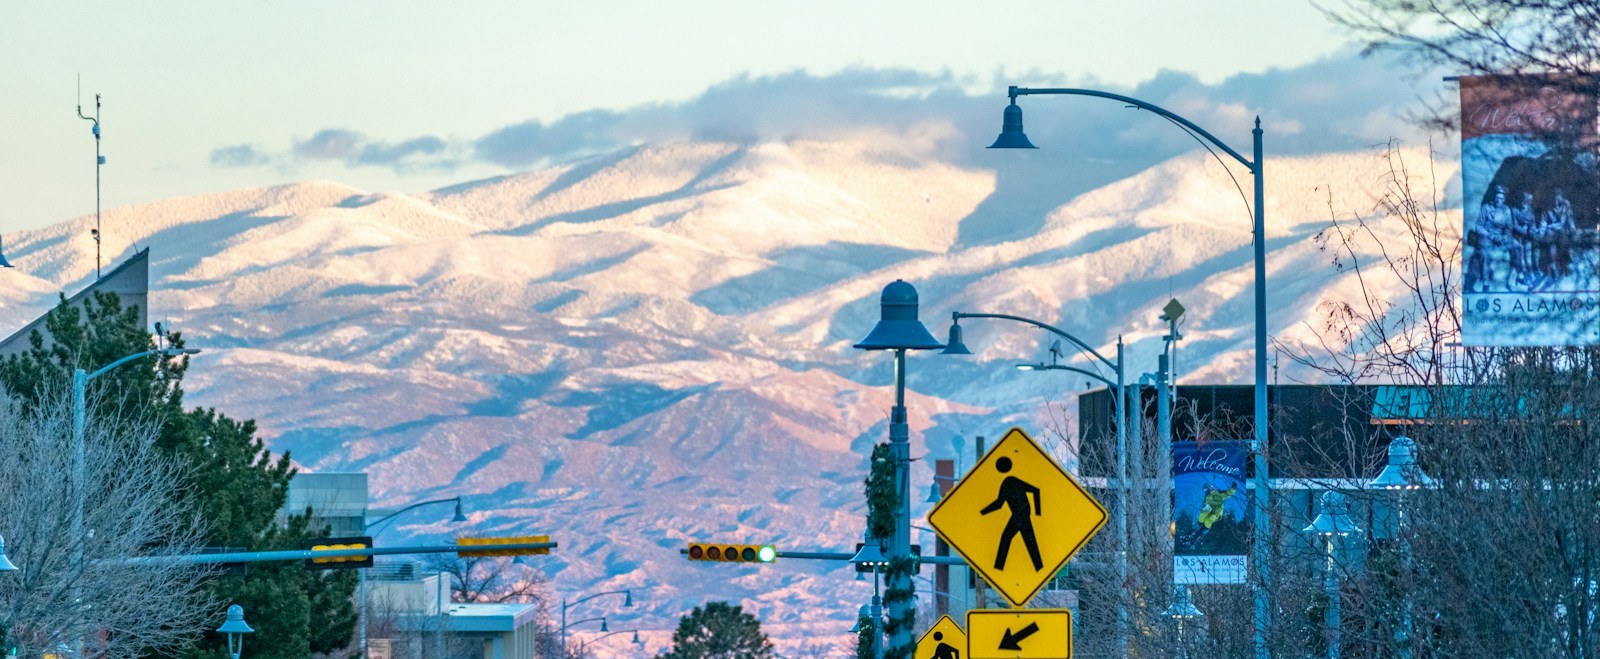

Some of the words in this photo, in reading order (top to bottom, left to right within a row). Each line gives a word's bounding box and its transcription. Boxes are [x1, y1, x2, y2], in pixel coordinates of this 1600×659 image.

[1466, 298, 1502, 313] LOS
[1512, 297, 1595, 312] ALAMOS
[1178, 448, 1241, 475] Welcome
[1176, 558, 1195, 567] LOS
[1202, 557, 1245, 566] ALAMOS
